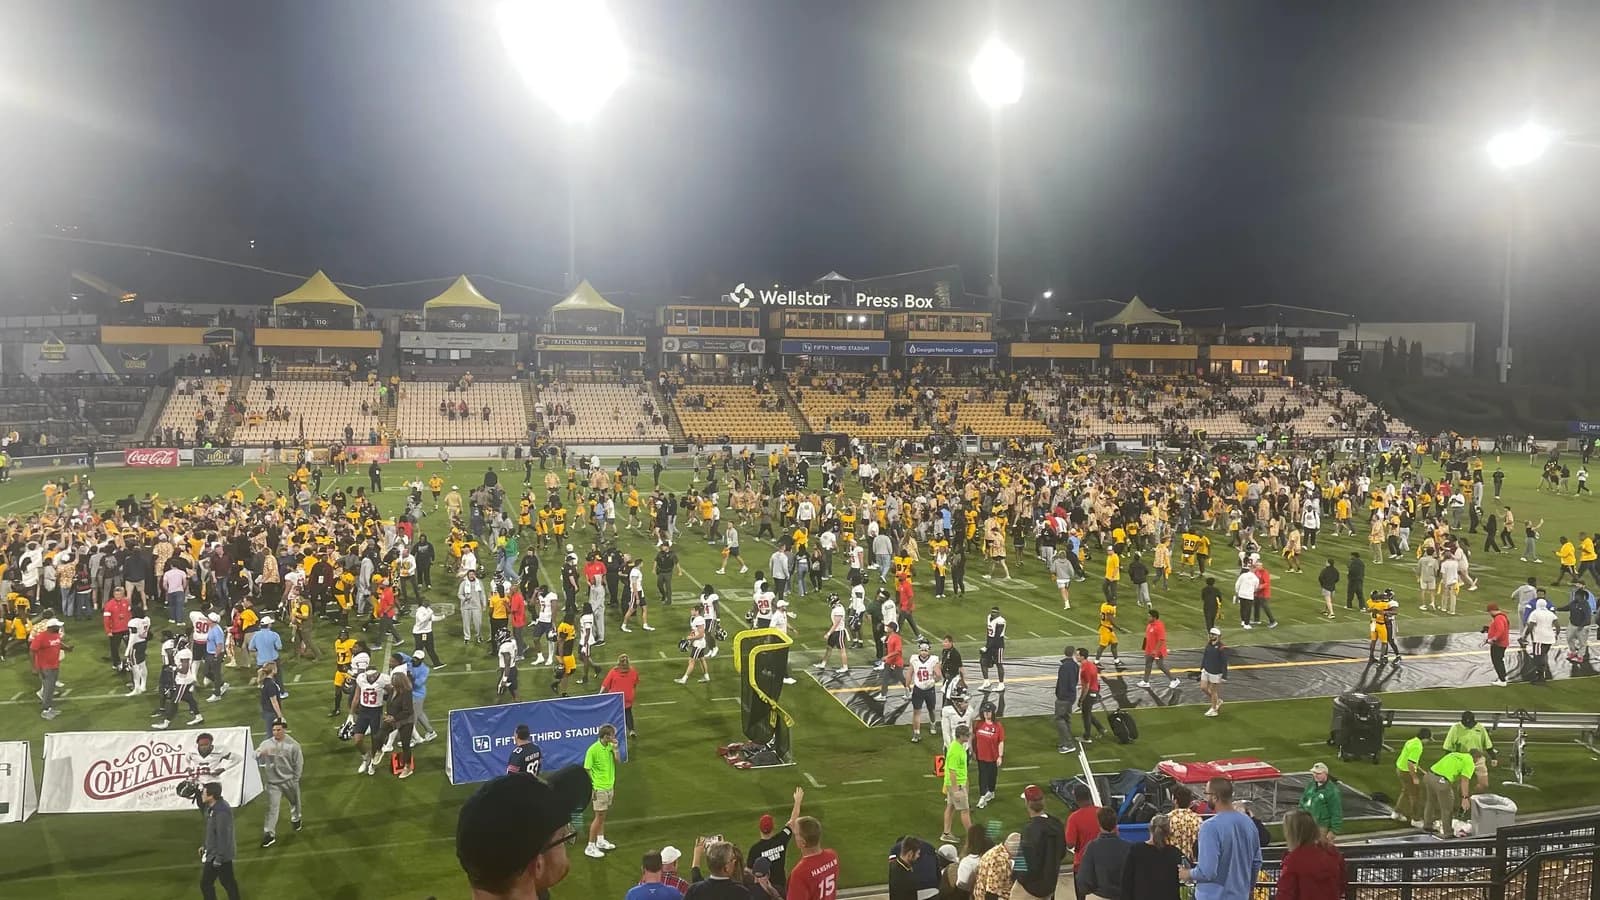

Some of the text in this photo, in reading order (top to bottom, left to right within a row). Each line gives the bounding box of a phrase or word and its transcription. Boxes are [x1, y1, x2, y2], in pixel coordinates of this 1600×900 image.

[760, 289, 933, 309] Wellstar Press Box
[195, 621, 209, 634] 90
[362, 689, 378, 705] 83
[495, 735, 517, 747] FIFT
[530, 730, 562, 742] THIRD
[565, 726, 601, 738] STADIU
[818, 873, 835, 899] 15
